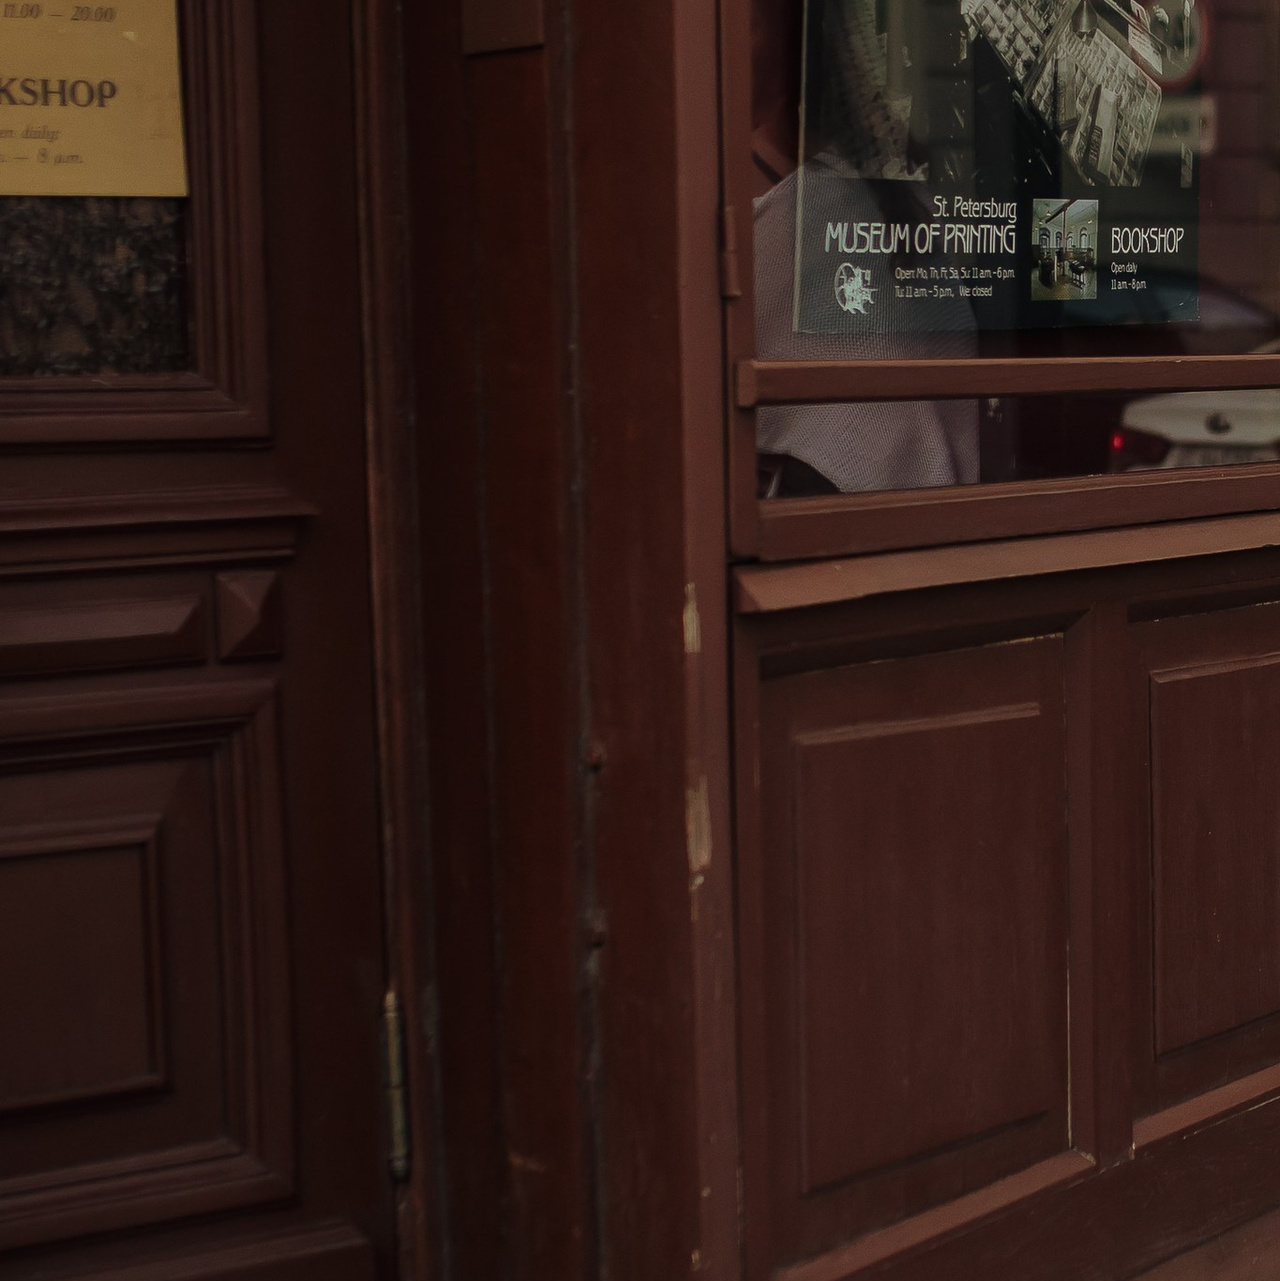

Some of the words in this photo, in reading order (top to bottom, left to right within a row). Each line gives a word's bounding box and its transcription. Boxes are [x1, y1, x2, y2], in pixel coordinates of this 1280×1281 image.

[70, 5, 116, 23] 20.00
[0, 77, 118, 108] KSHOP
[932, 195, 949, 218] St.
[953, 196, 1017, 223] Petersburg
[824, 222, 910, 254] MUSEUM
[914, 223, 941, 254] OF
[943, 223, 1016, 254] PRINTING
[1111, 227, 1185, 254] BOOKSHOP
[1110, 261, 1125, 275] Open
